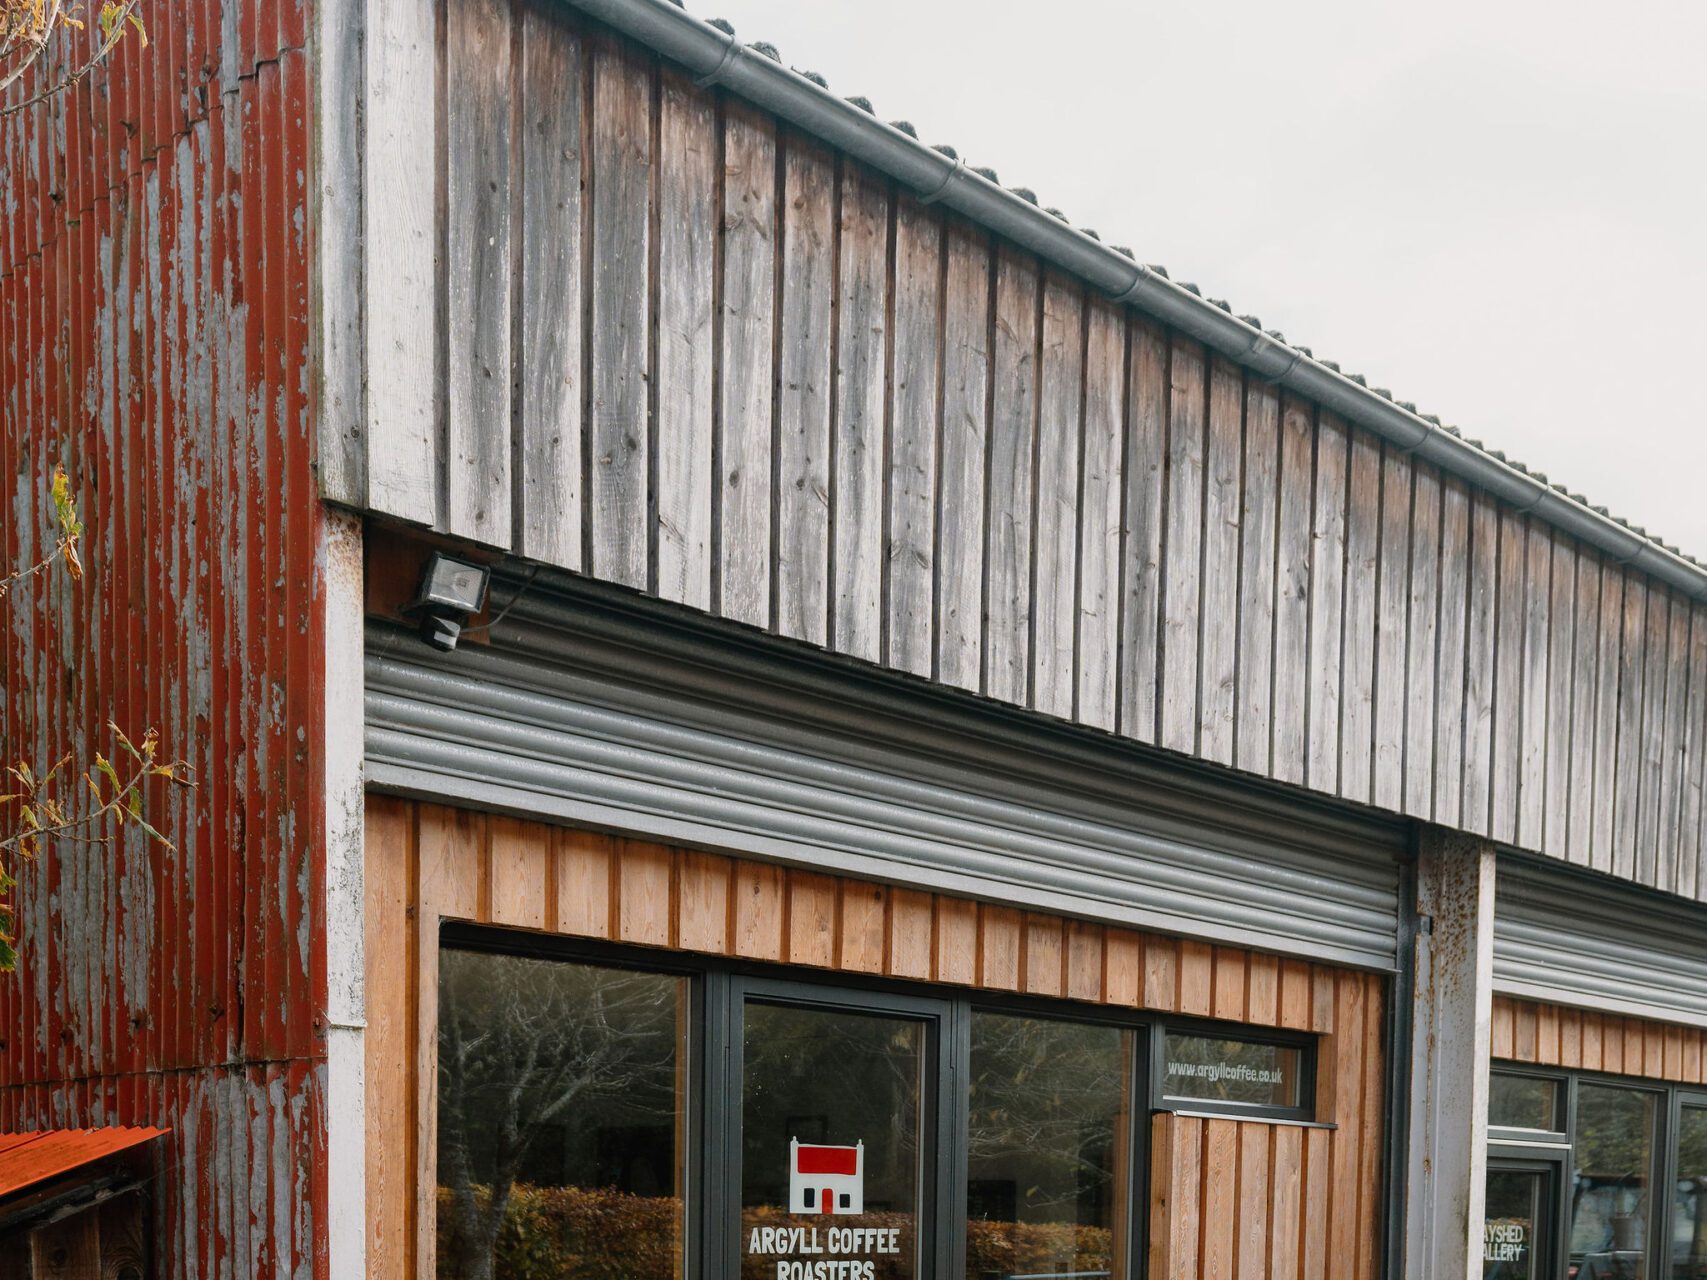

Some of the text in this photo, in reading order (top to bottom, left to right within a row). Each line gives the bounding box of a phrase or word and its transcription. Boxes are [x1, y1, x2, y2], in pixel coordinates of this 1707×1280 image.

[1168, 1062, 1283, 1085] www.argyllcoffee.co.uk
[748, 1227, 900, 1254] ARGYLL COFFEE
[1483, 1224, 1523, 1243] AYSHED
[1482, 1243, 1521, 1262] ALLERY
